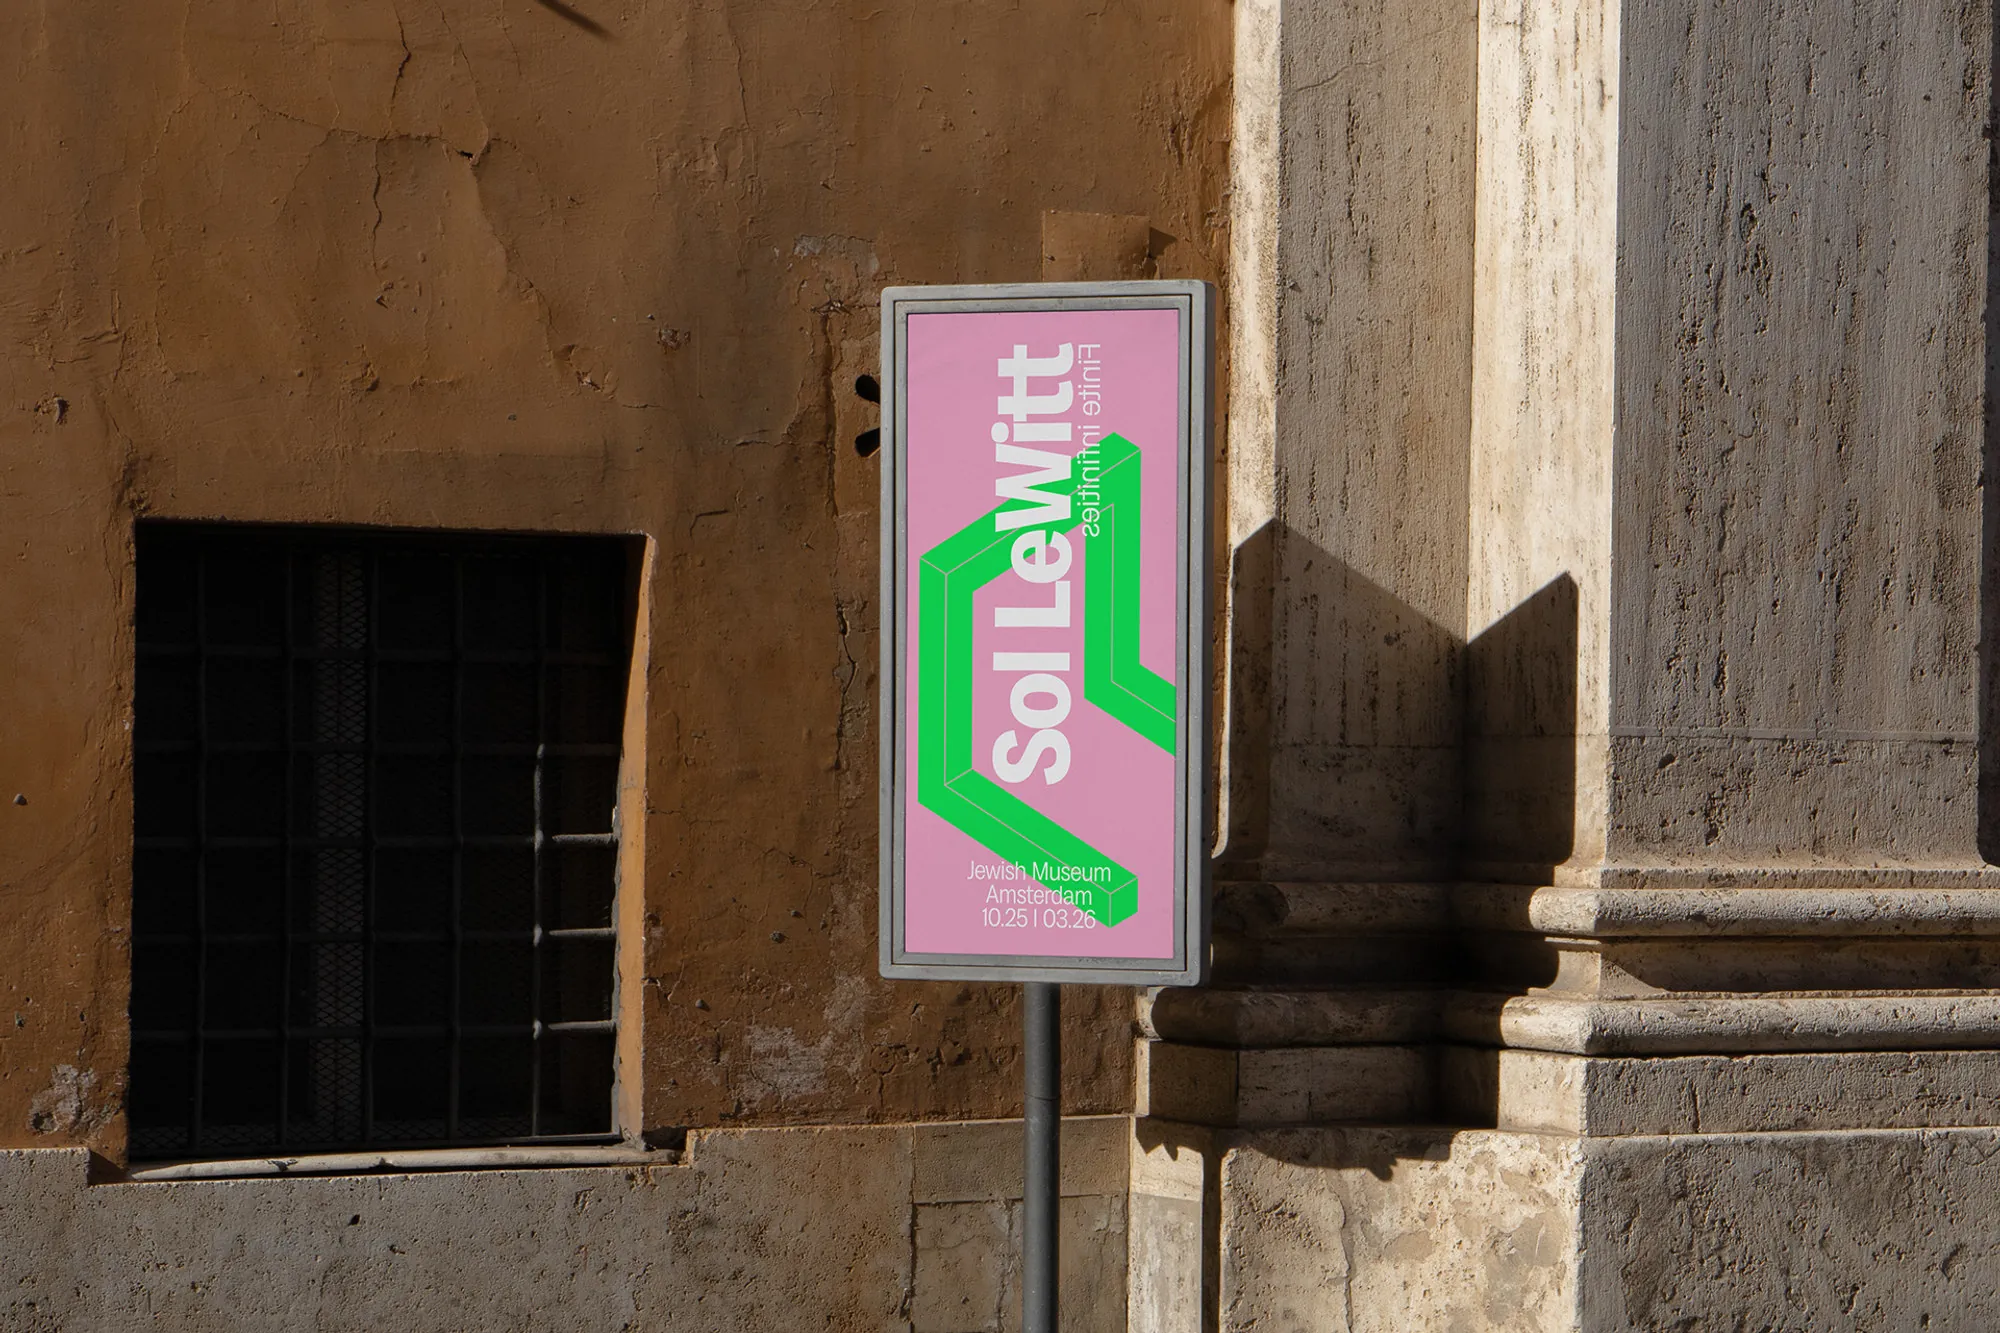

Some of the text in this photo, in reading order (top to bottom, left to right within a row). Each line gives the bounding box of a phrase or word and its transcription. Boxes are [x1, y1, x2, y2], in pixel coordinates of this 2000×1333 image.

[990, 342, 1074, 786] Sol LeWitt
[967, 860, 1112, 883] Jewish Museum
[985, 884, 1093, 906] Amsterdam
[982, 907, 1028, 928] 10.25
[1042, 907, 1097, 930] 03.26
